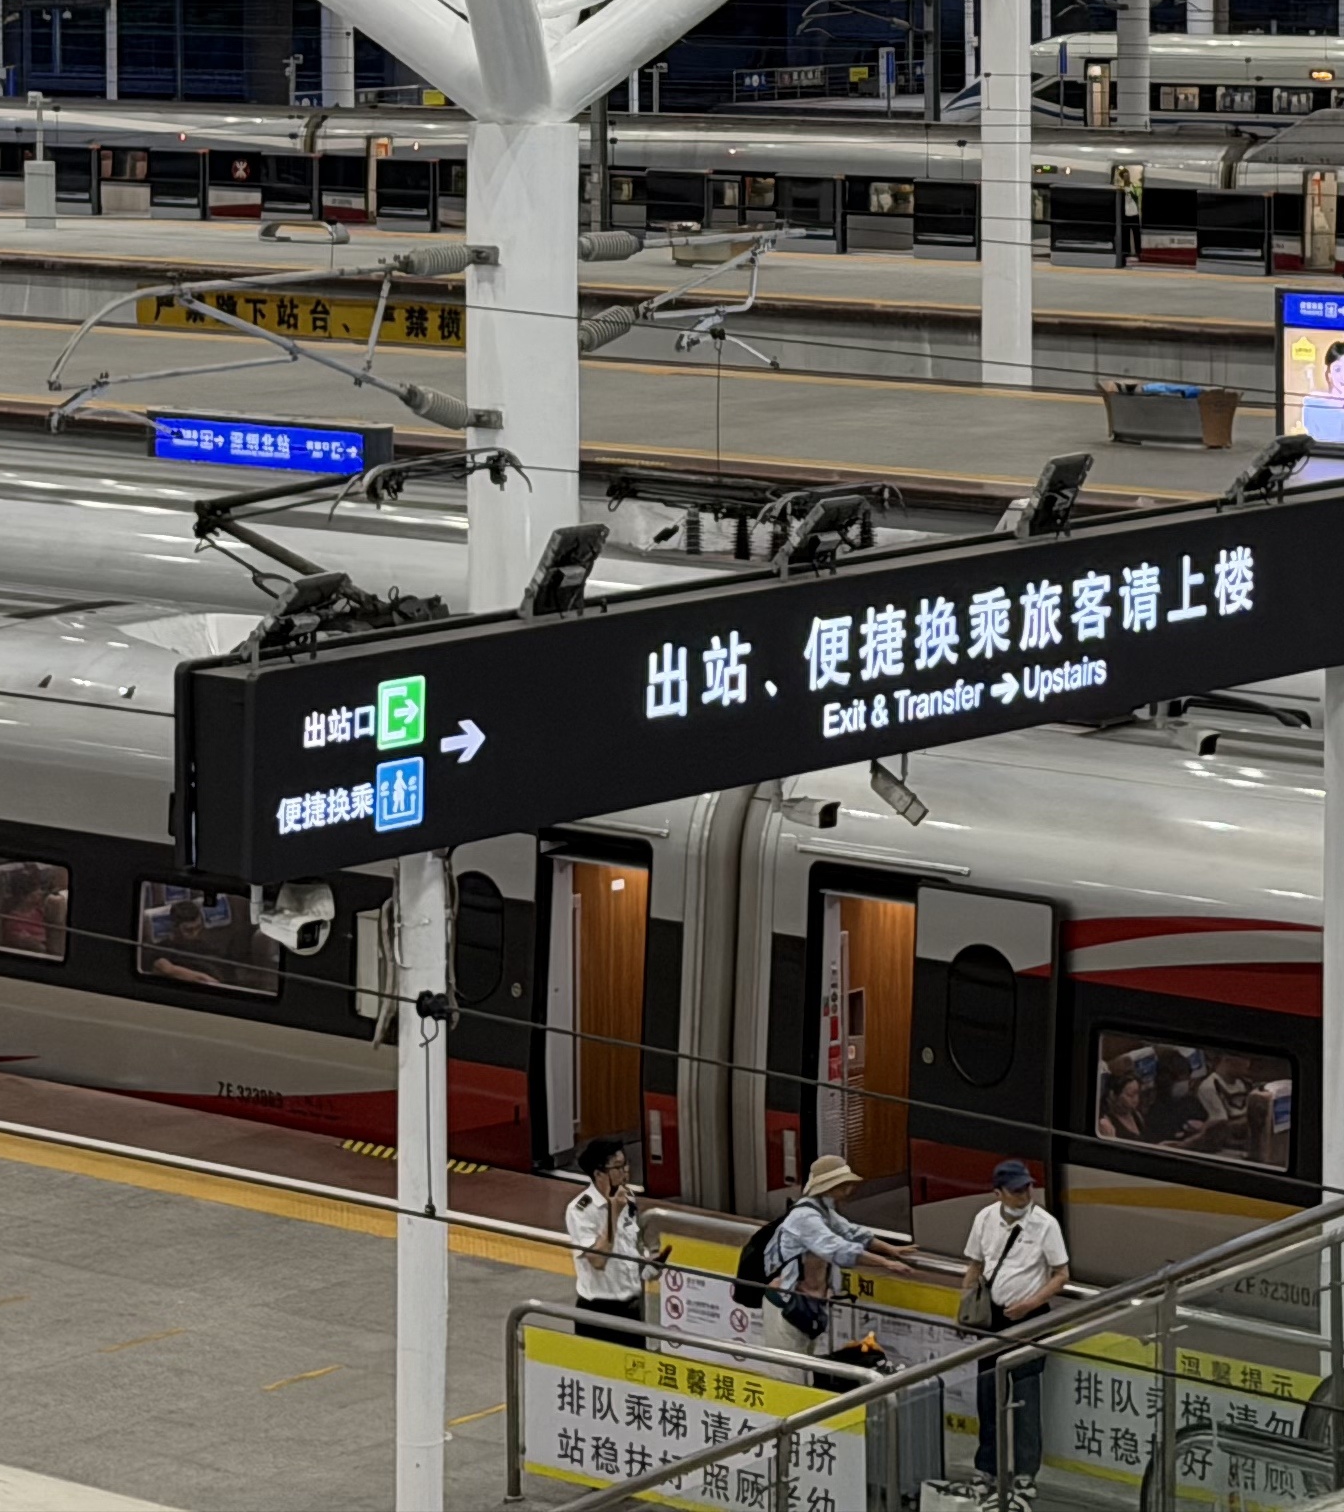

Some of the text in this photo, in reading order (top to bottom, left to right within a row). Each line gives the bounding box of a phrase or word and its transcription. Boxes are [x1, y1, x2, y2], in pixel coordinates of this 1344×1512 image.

[646, 546, 1254, 719] 出站、便捷换乘旅客请上楼
[822, 656, 1107, 738] Exit & Transfer Upstairs
[303, 705, 375, 748] 出站口
[276, 782, 374, 834] 便捷换乘
[557, 1376, 688, 1441] 排队乘梯
[658, 1361, 765, 1408] 温馨提示
